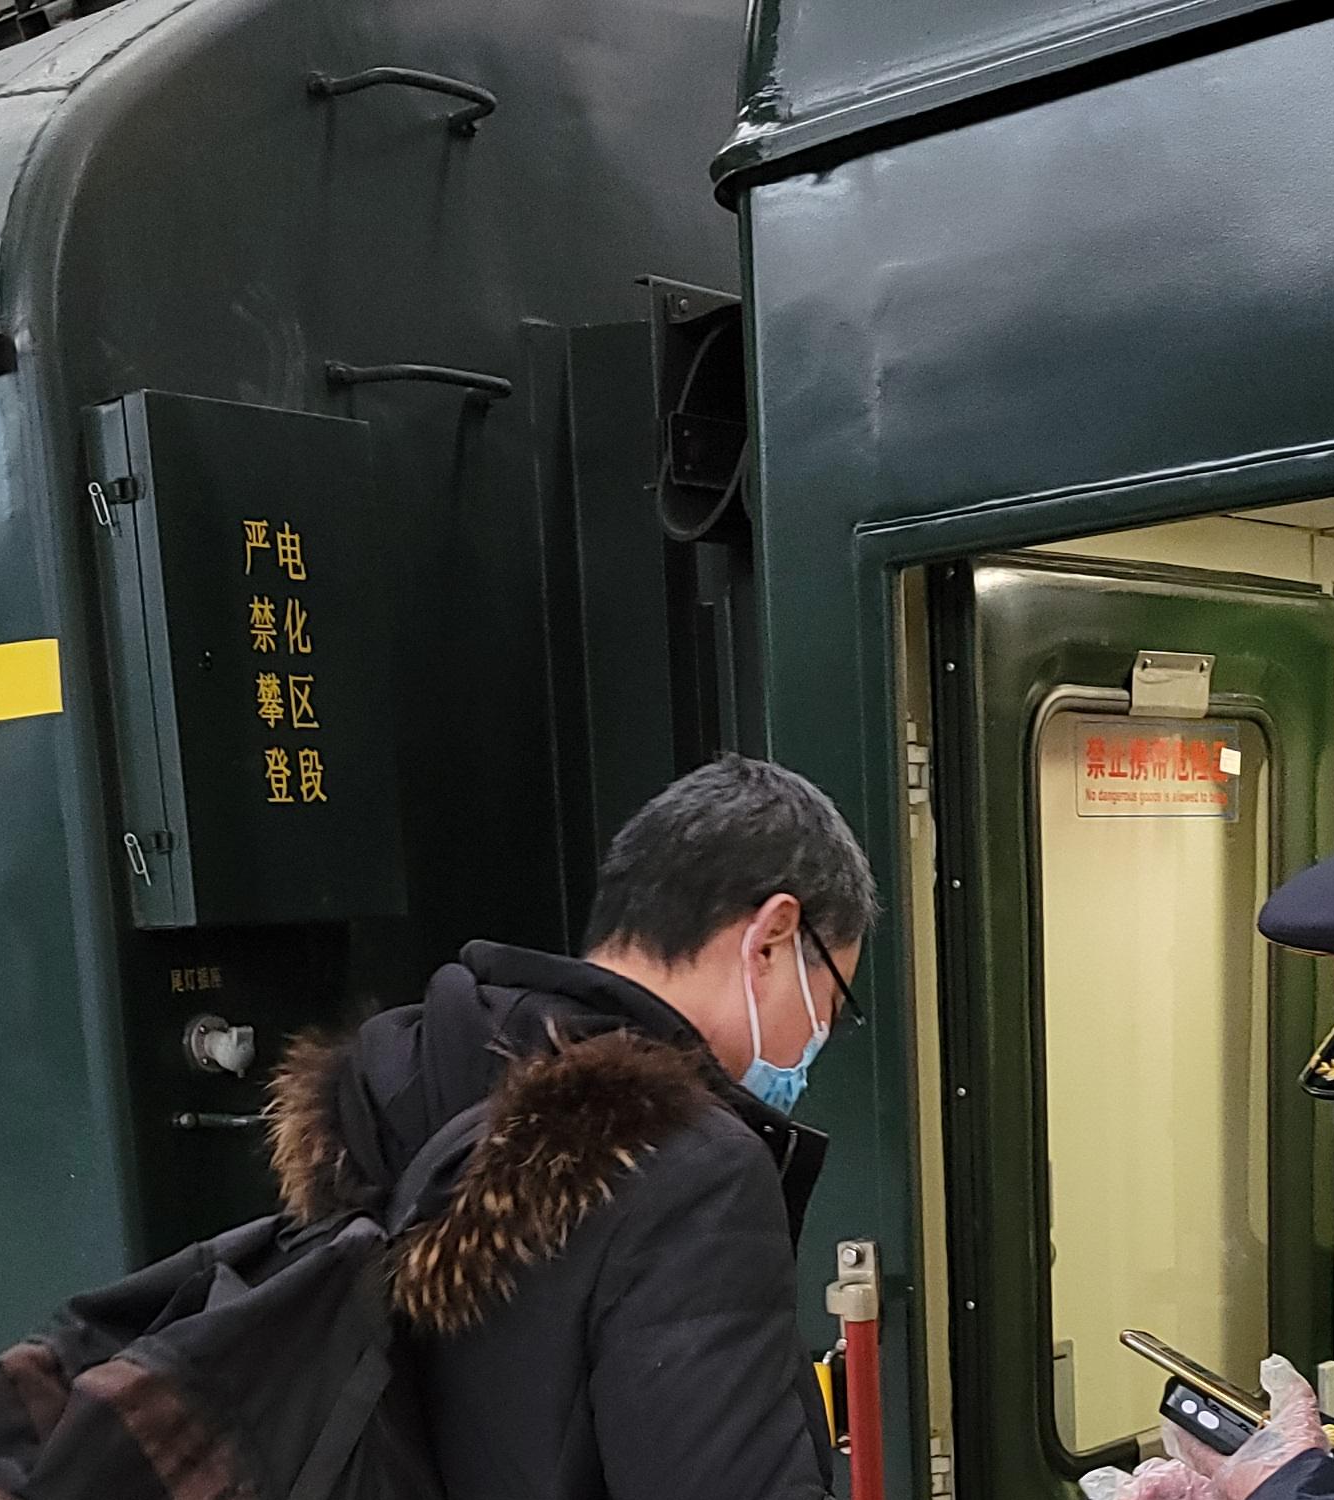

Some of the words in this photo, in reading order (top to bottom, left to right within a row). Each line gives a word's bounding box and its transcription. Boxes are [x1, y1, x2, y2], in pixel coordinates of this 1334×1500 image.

[242, 518, 295, 804] 严禁攀登
[275, 520, 328, 803] 电化区段
